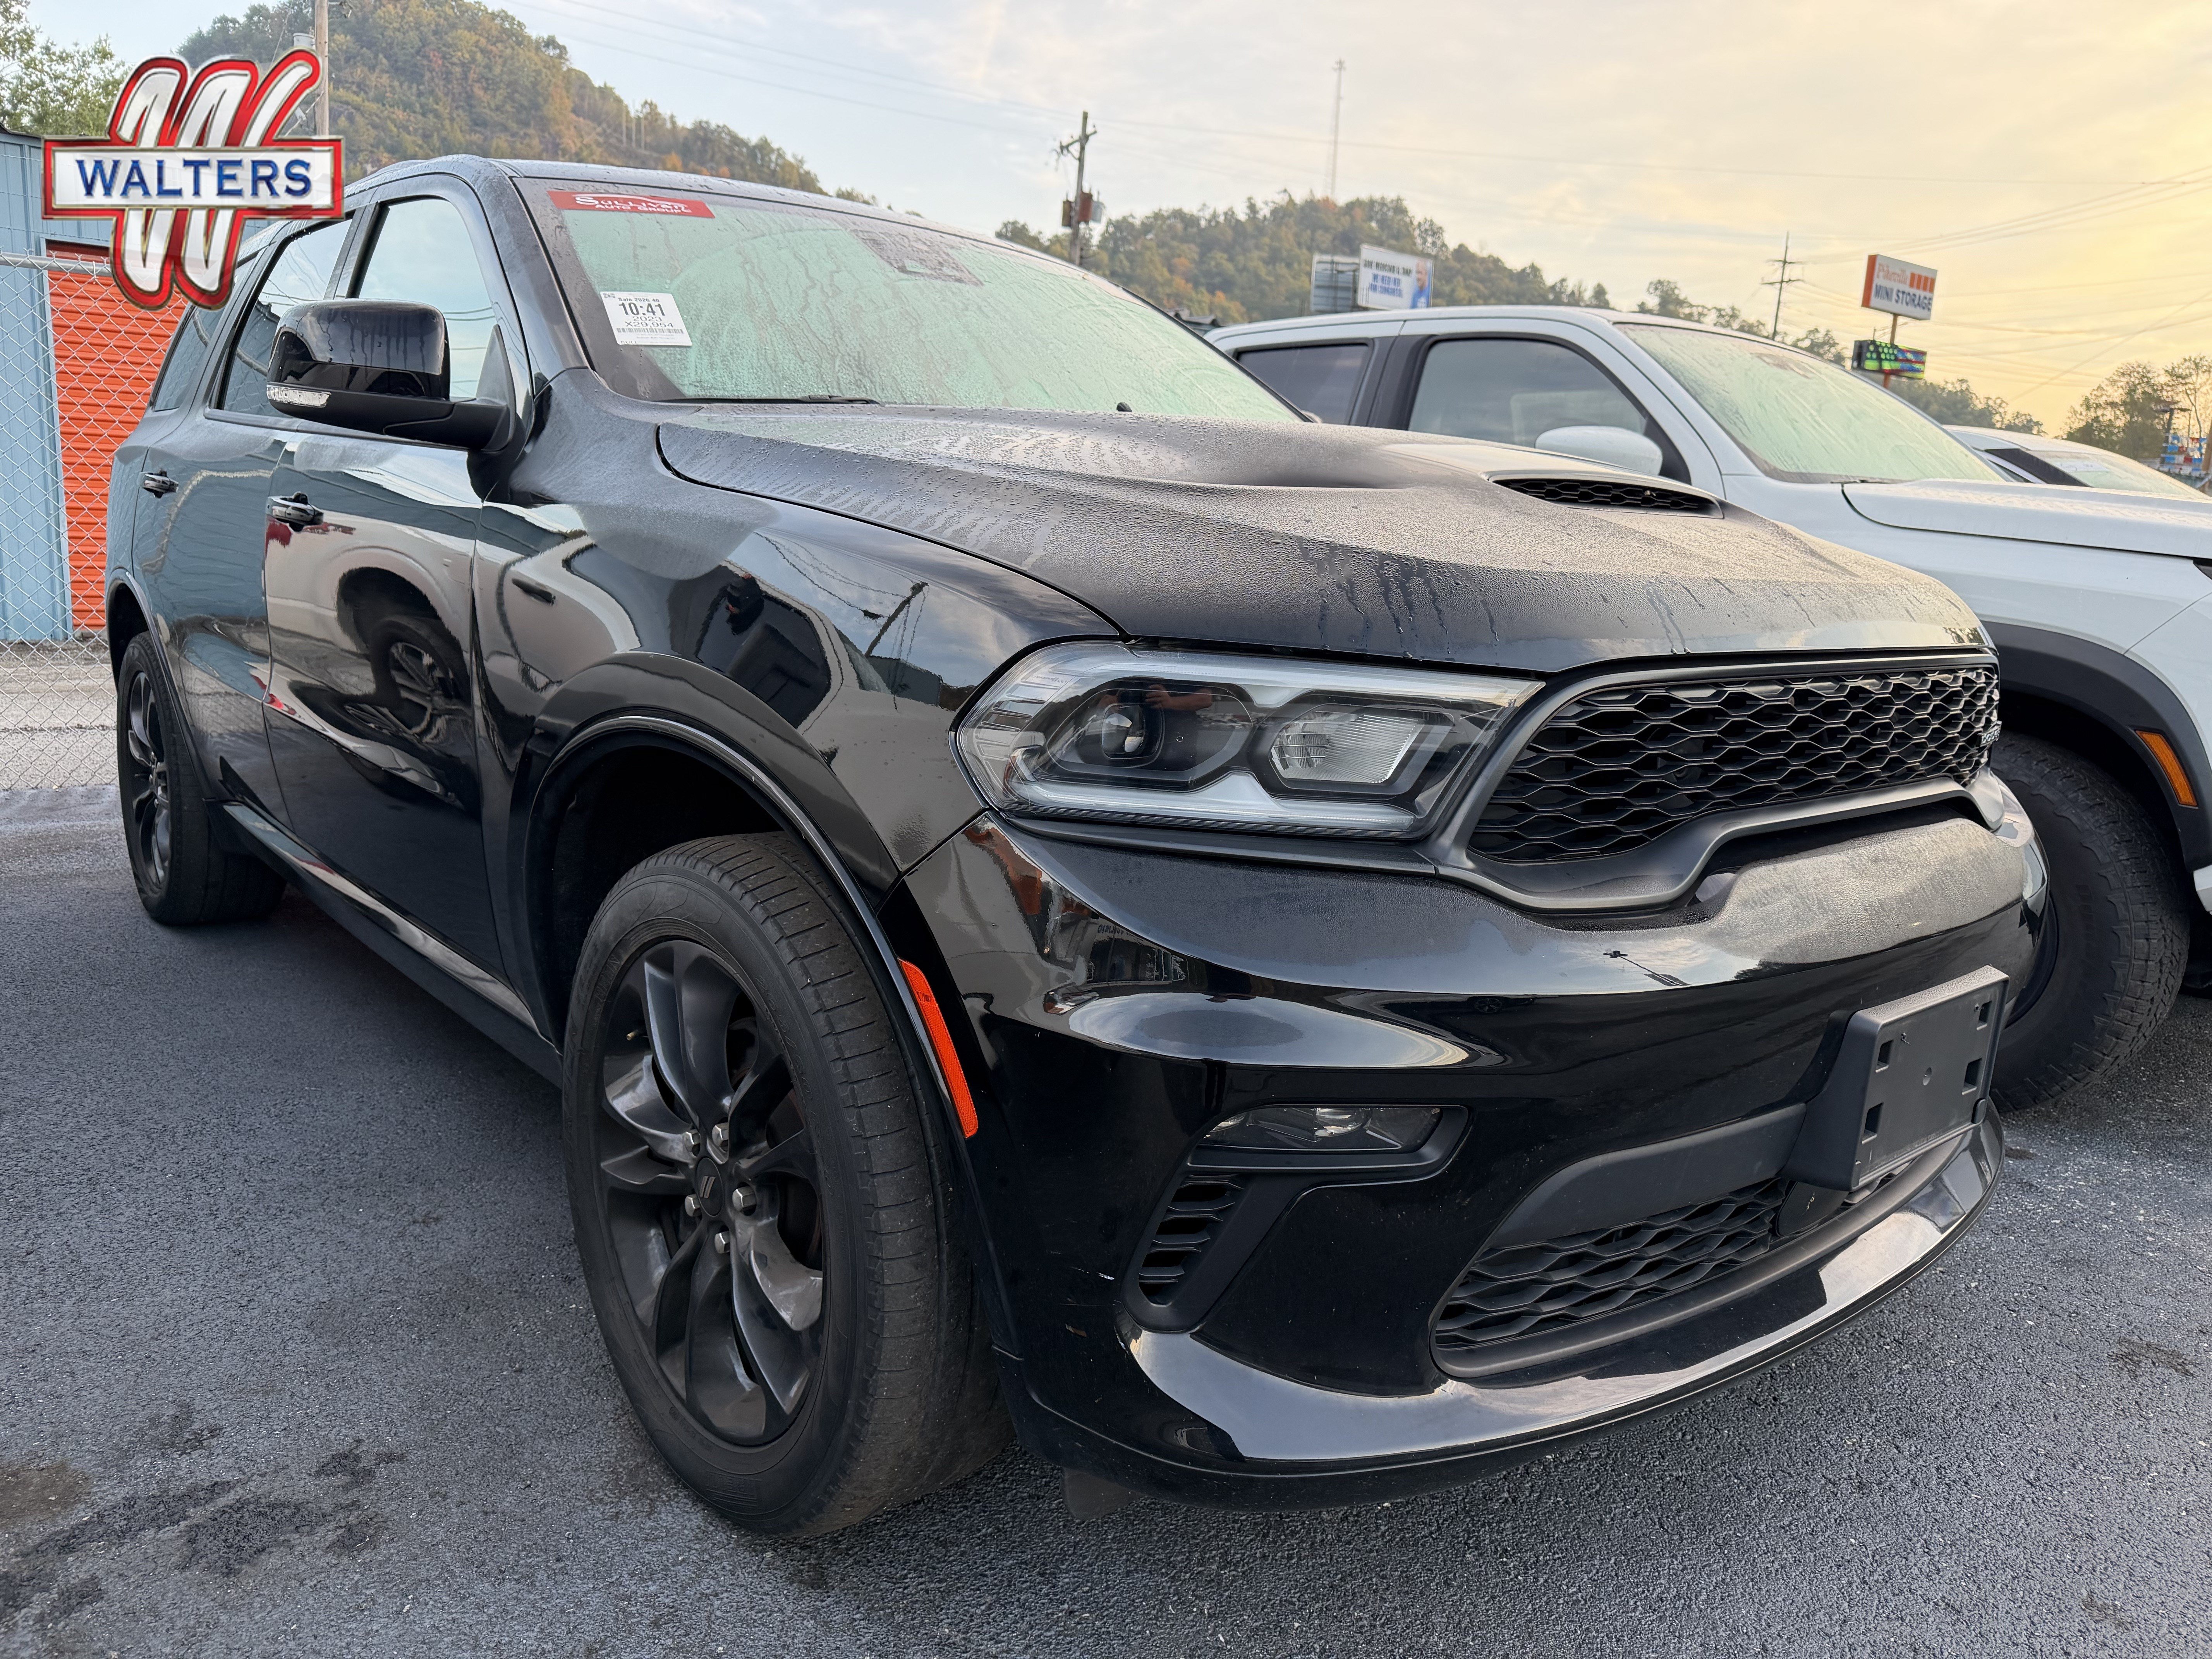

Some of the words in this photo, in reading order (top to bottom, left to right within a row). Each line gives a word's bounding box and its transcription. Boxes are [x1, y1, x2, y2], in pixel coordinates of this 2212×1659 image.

[1874, 283, 1894, 302] MINI
[1895, 289, 1932, 311] STORAGE
[618, 302, 666, 316] 10:41
